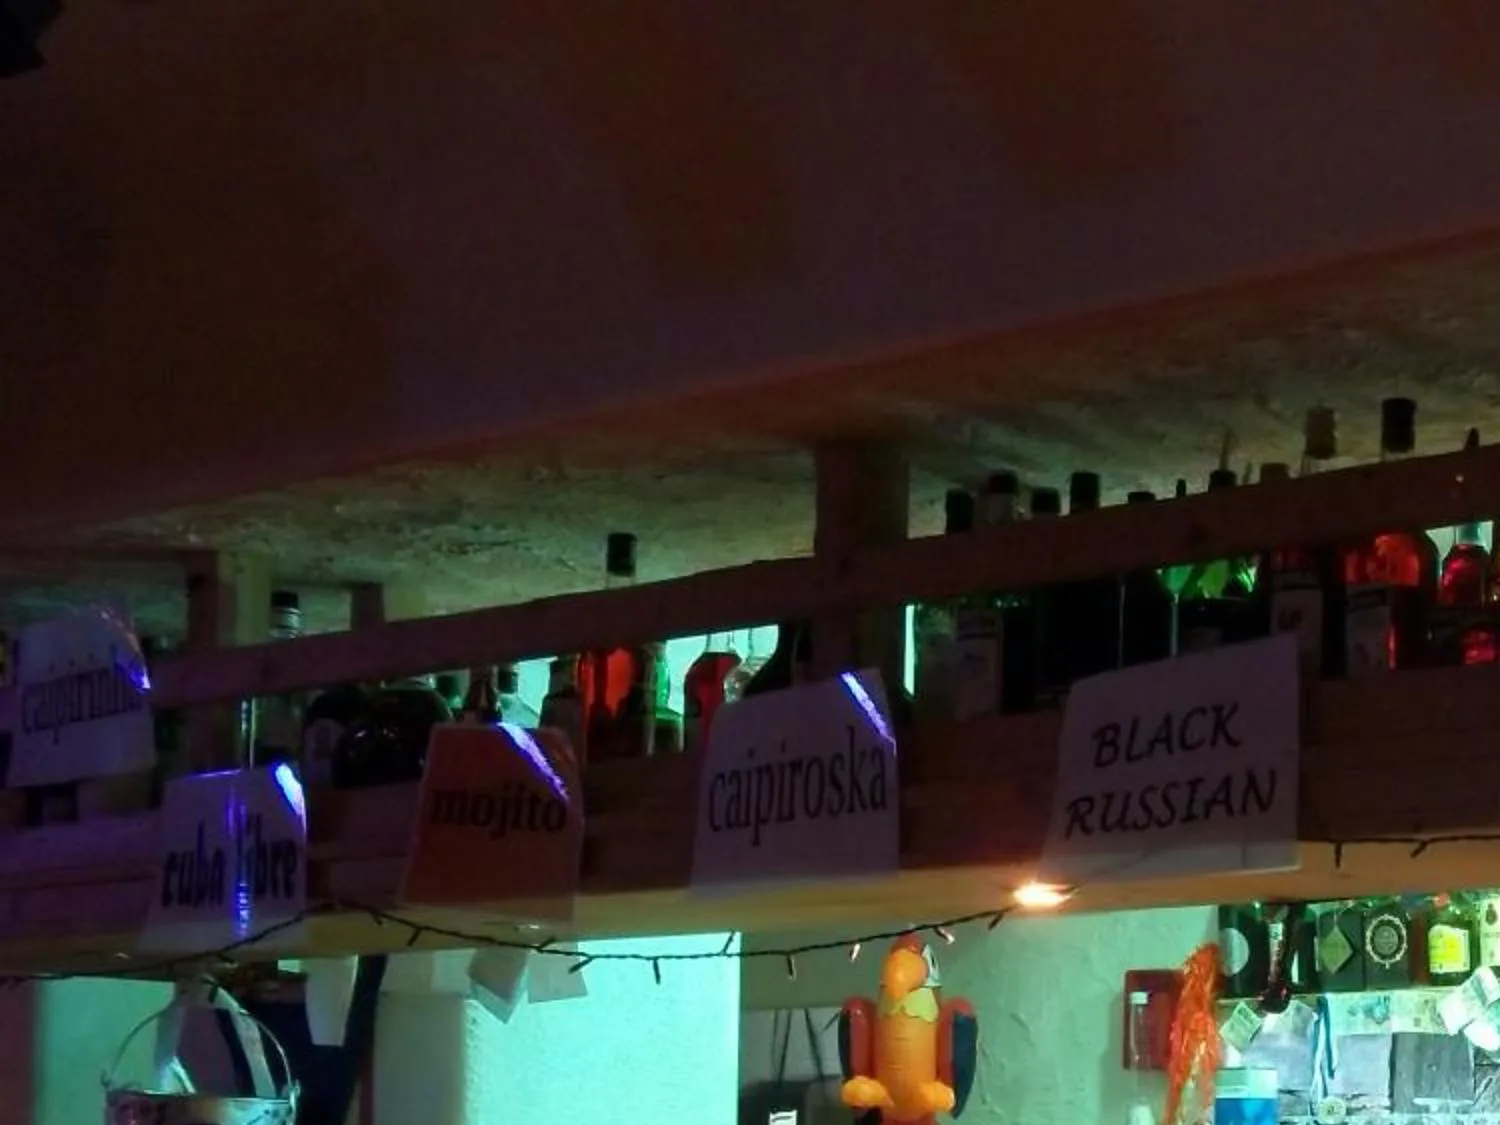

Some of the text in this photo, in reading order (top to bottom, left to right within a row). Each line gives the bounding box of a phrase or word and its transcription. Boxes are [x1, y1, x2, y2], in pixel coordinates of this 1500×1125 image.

[1091, 702, 1242, 768] BLACK
[429, 785, 568, 838] mojito
[708, 726, 888, 847] caipiroska
[1064, 768, 1278, 841] RUSSIAN
[161, 815, 227, 909] cuba
